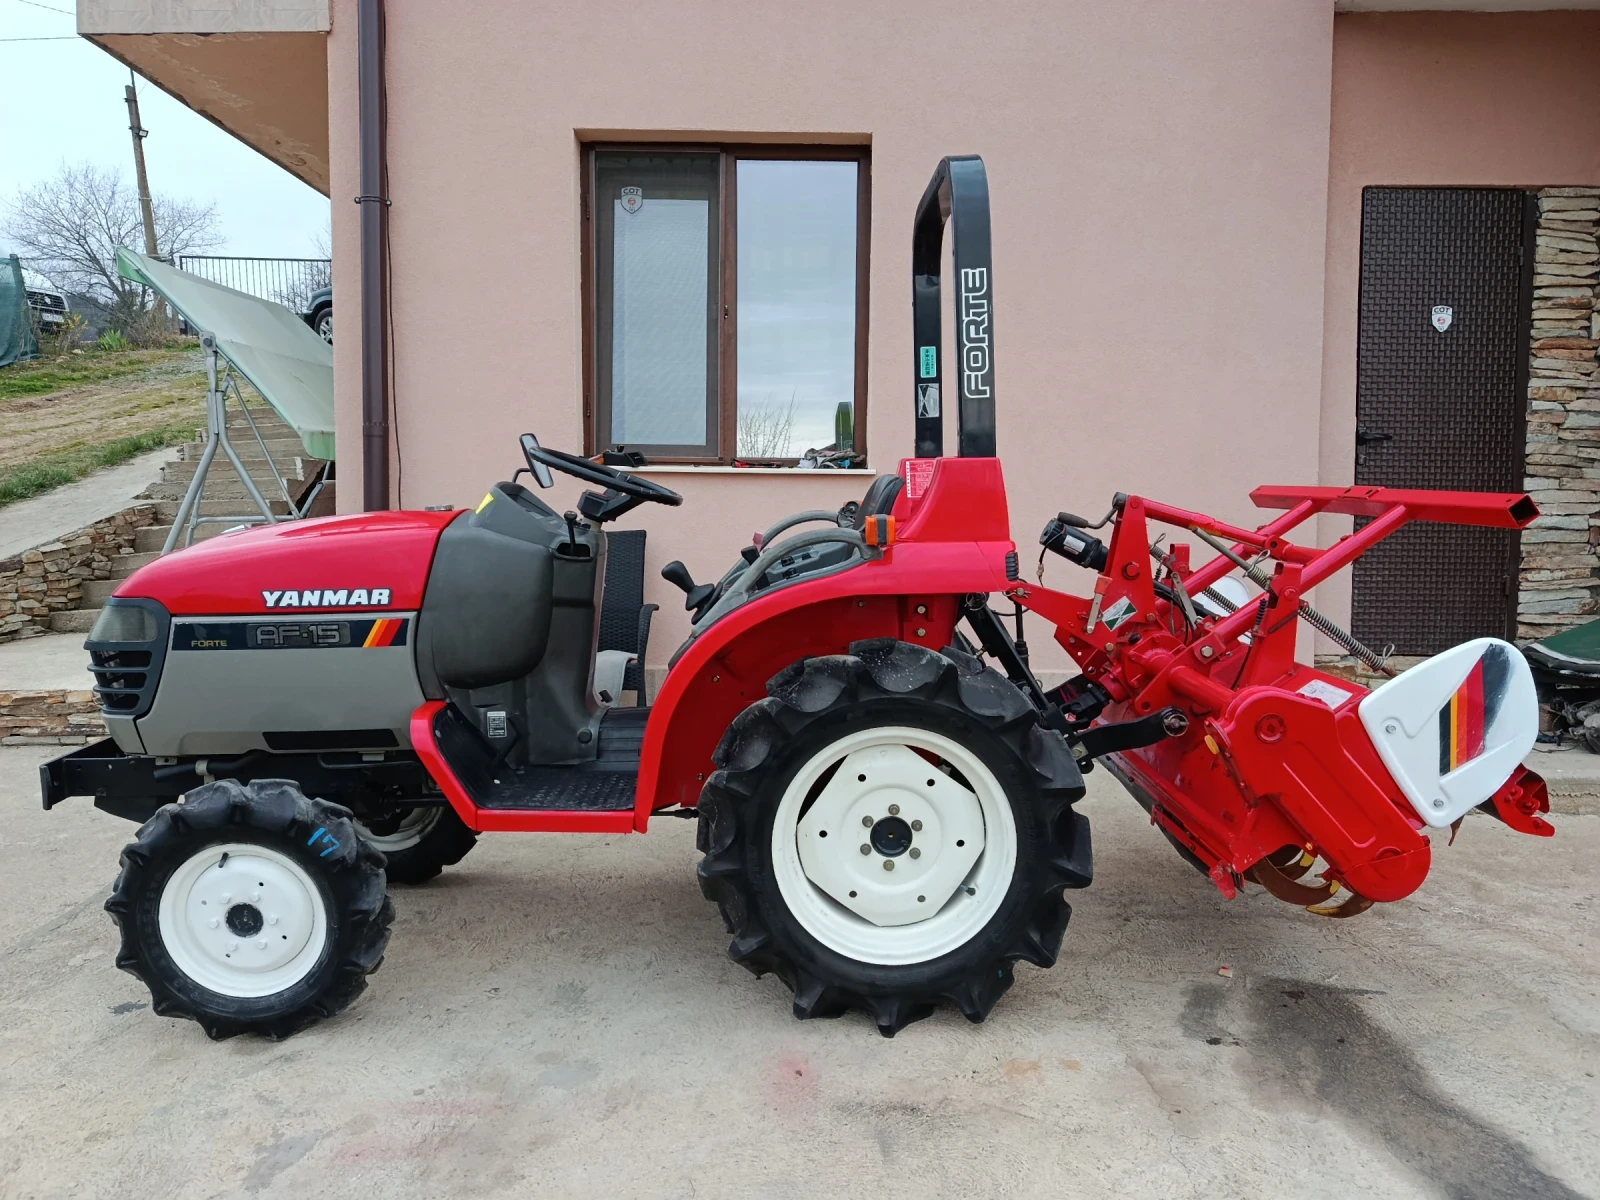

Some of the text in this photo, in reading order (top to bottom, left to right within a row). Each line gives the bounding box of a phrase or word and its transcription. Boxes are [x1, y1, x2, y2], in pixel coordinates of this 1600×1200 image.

[961, 267, 990, 399] FORTE
[262, 588, 391, 607] YANMAR
[191, 639, 228, 648] FORTE
